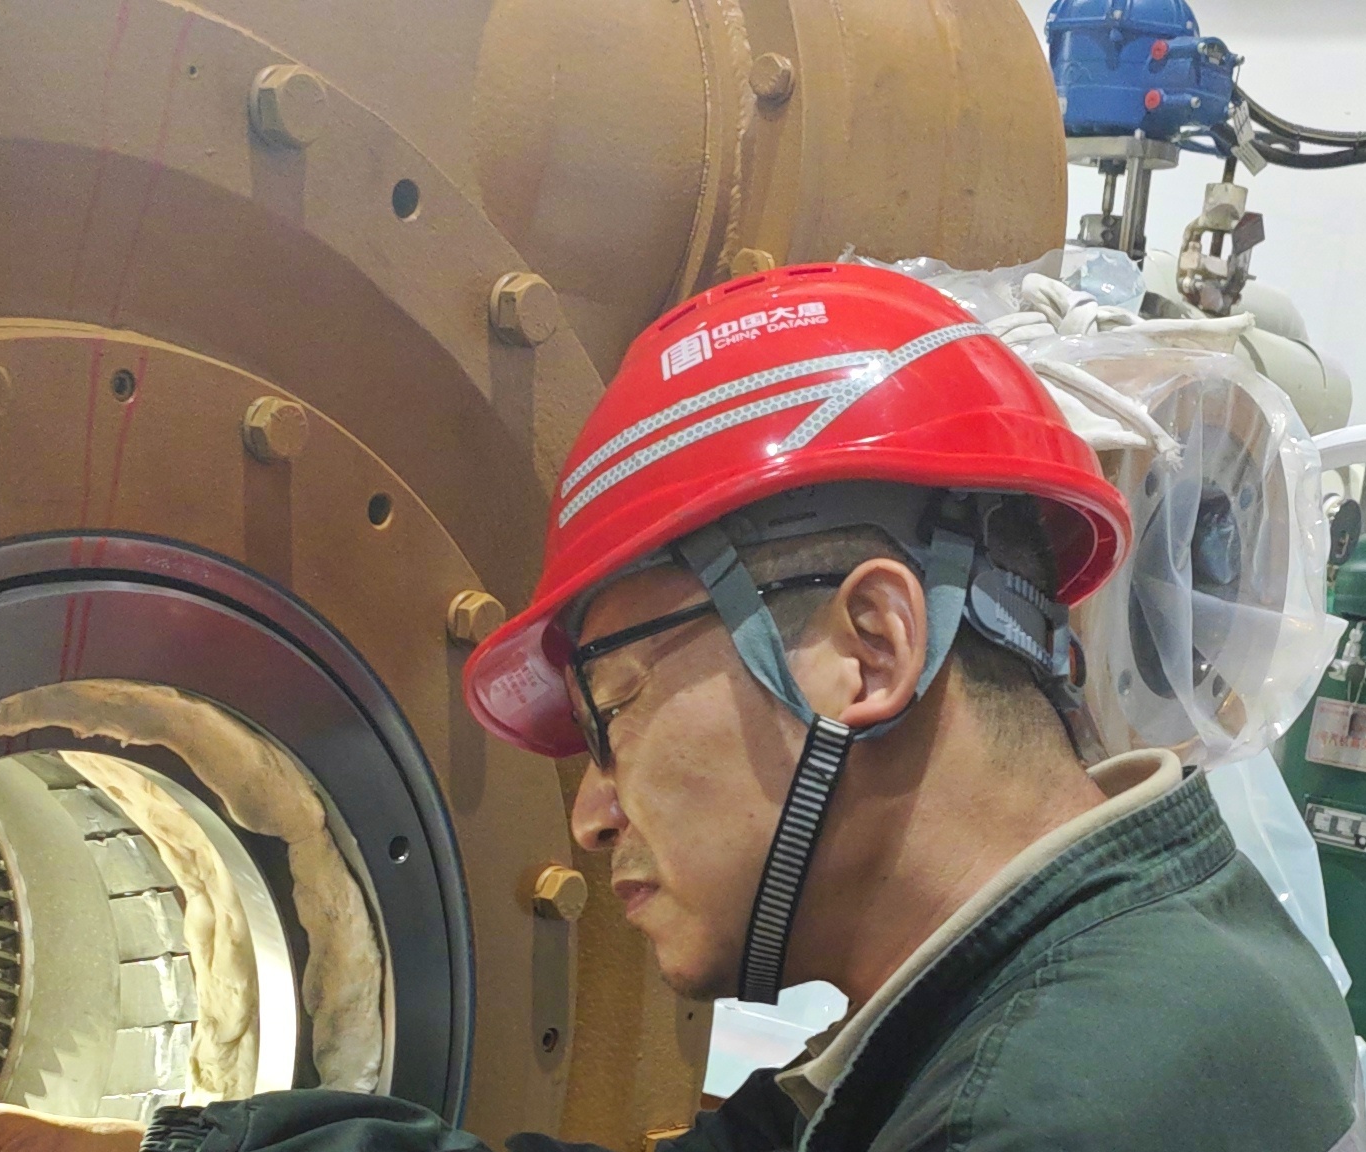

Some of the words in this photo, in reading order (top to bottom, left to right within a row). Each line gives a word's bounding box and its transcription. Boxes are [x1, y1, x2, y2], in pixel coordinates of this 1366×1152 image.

[711, 301, 826, 340] 中国大唐
[713, 328, 761, 350] CHINA
[766, 315, 829, 334] DATANG
